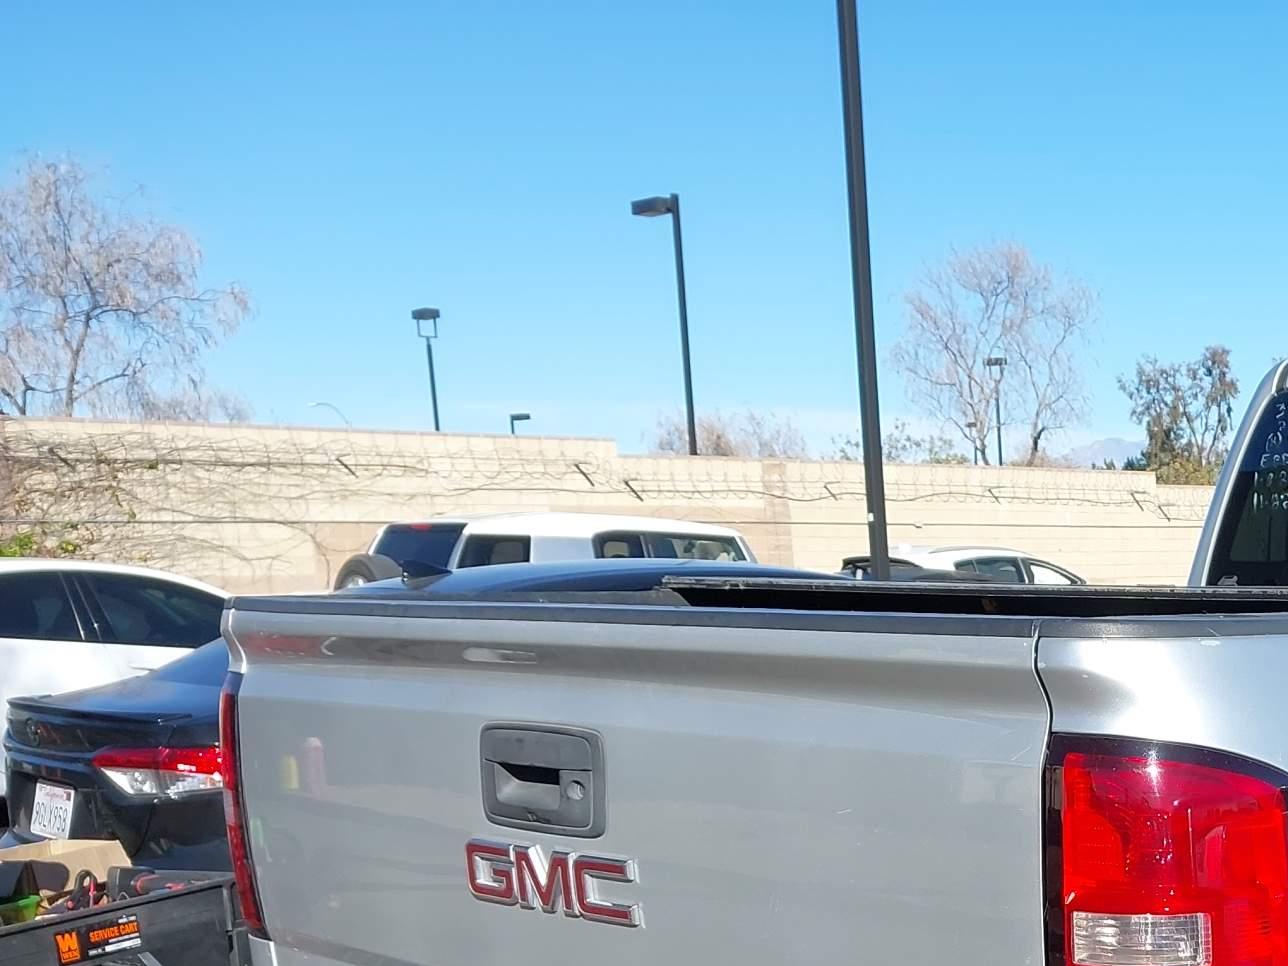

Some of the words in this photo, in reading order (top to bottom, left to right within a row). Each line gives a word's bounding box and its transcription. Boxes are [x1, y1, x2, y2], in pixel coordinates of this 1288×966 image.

[465, 838, 642, 928] GMC
[89, 926, 120, 943] SERVICE
[119, 921, 139, 936] CART
